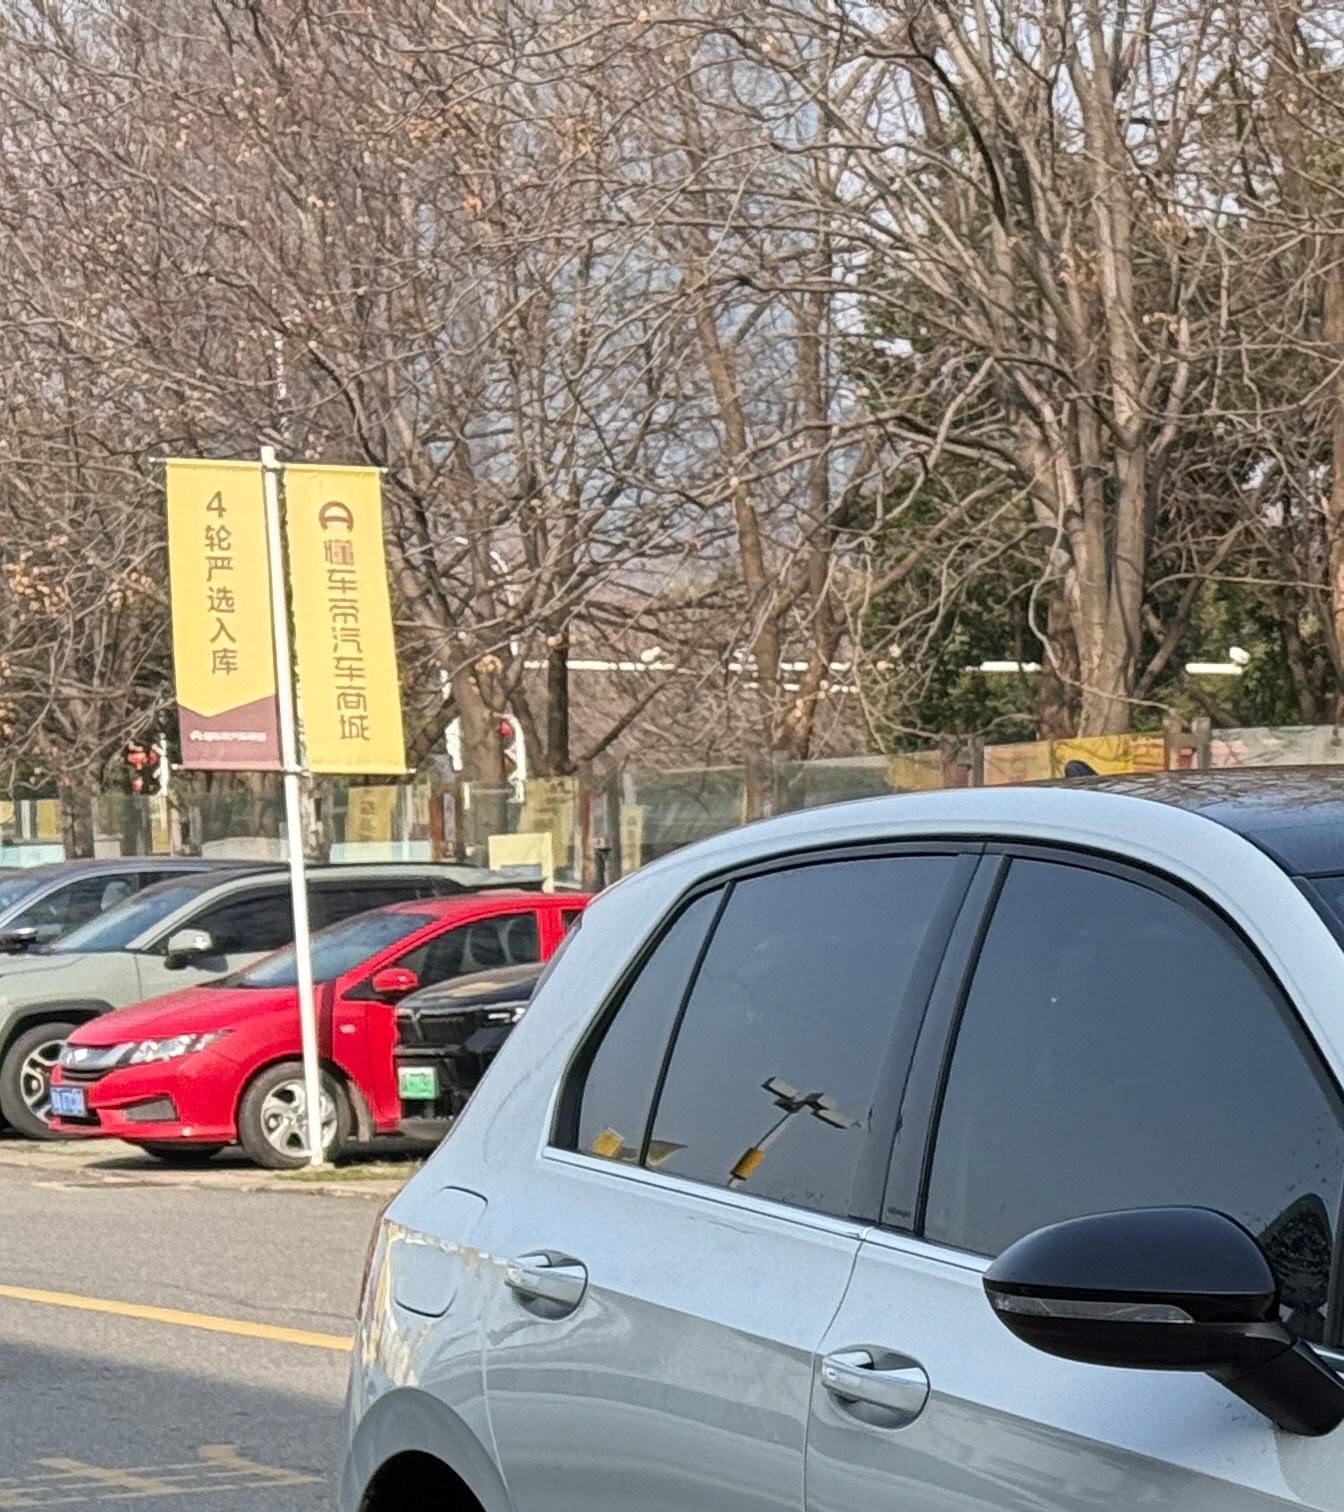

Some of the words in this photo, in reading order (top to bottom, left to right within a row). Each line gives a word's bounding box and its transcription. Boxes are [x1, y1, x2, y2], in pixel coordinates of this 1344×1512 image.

[204, 490, 239, 676] 4轮严选入库
